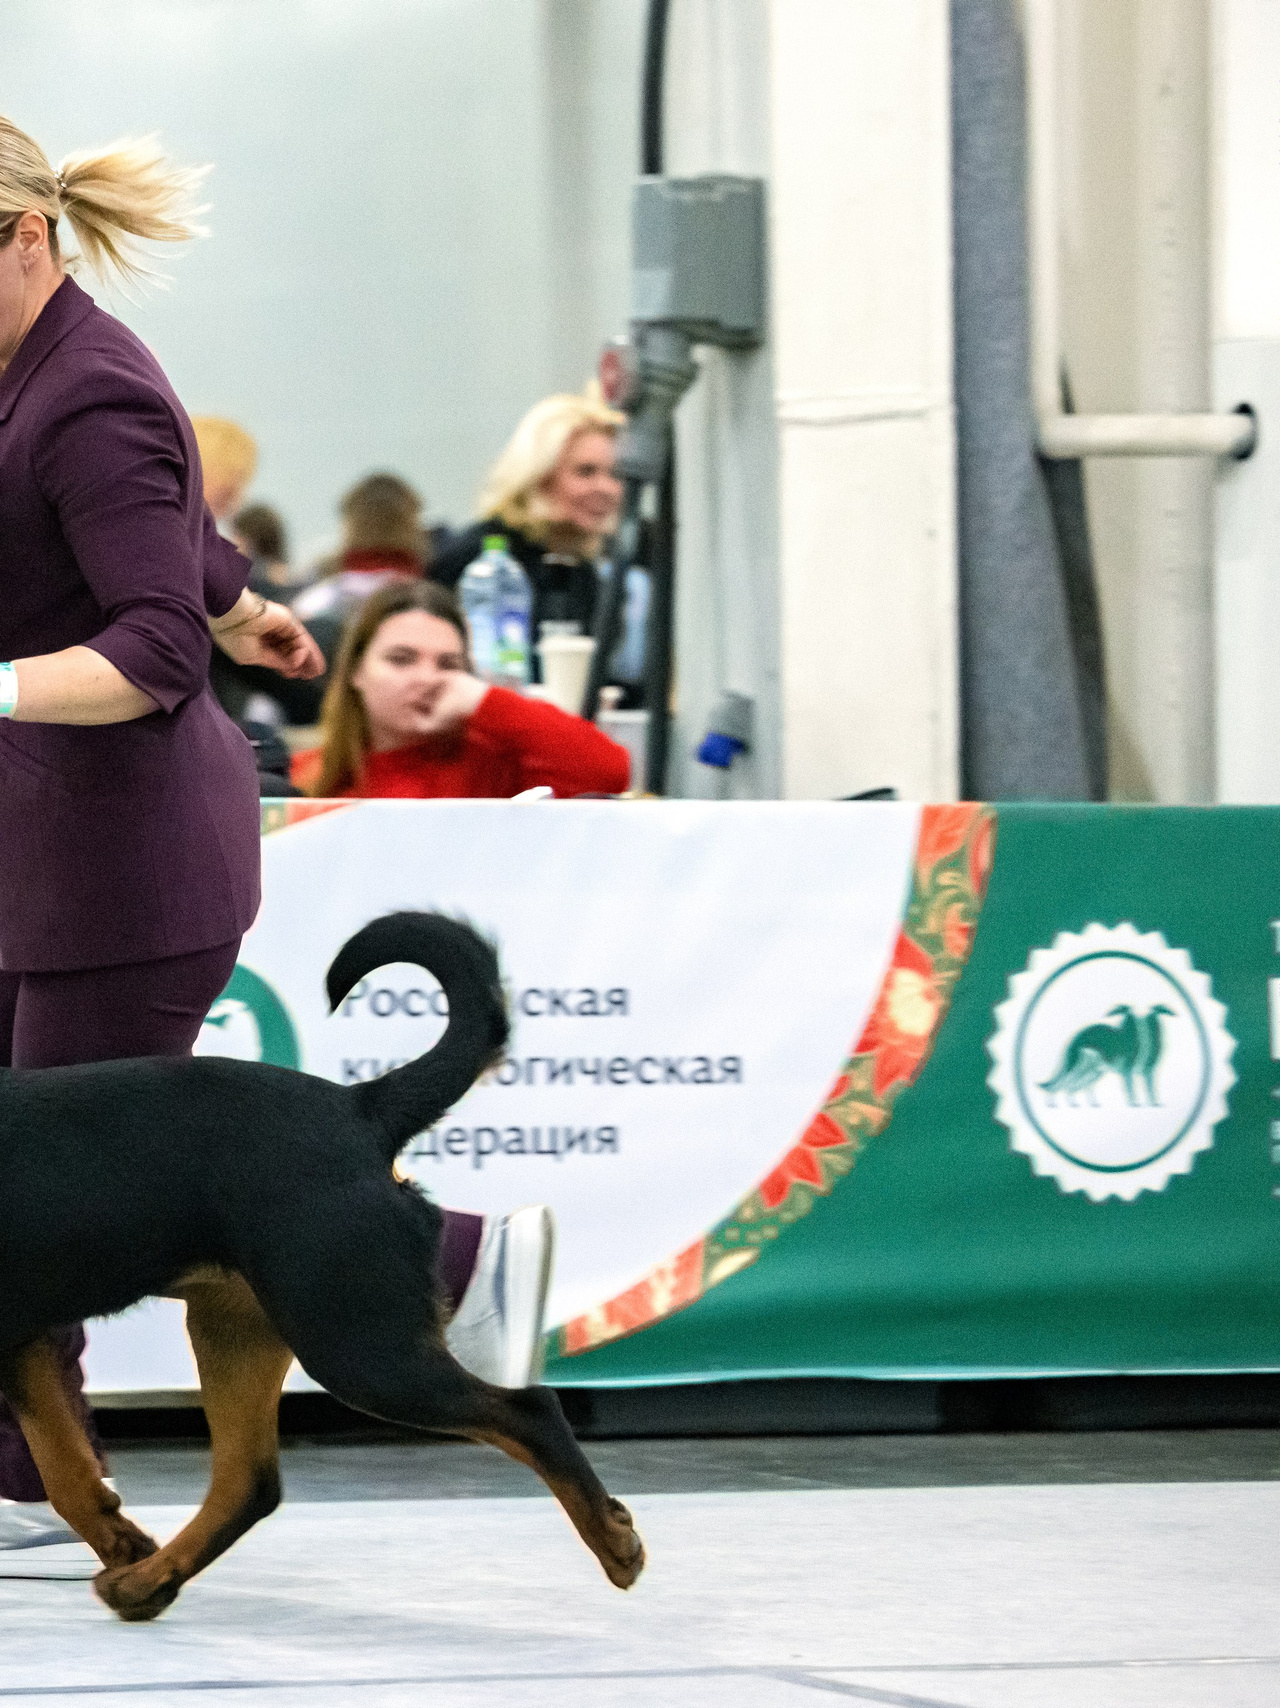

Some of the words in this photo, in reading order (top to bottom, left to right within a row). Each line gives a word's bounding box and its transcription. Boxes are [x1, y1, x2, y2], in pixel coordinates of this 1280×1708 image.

[341, 978, 629, 1017] Россская
[341, 1055, 743, 1087] киогическая
[407, 1123, 619, 1167] дерация
